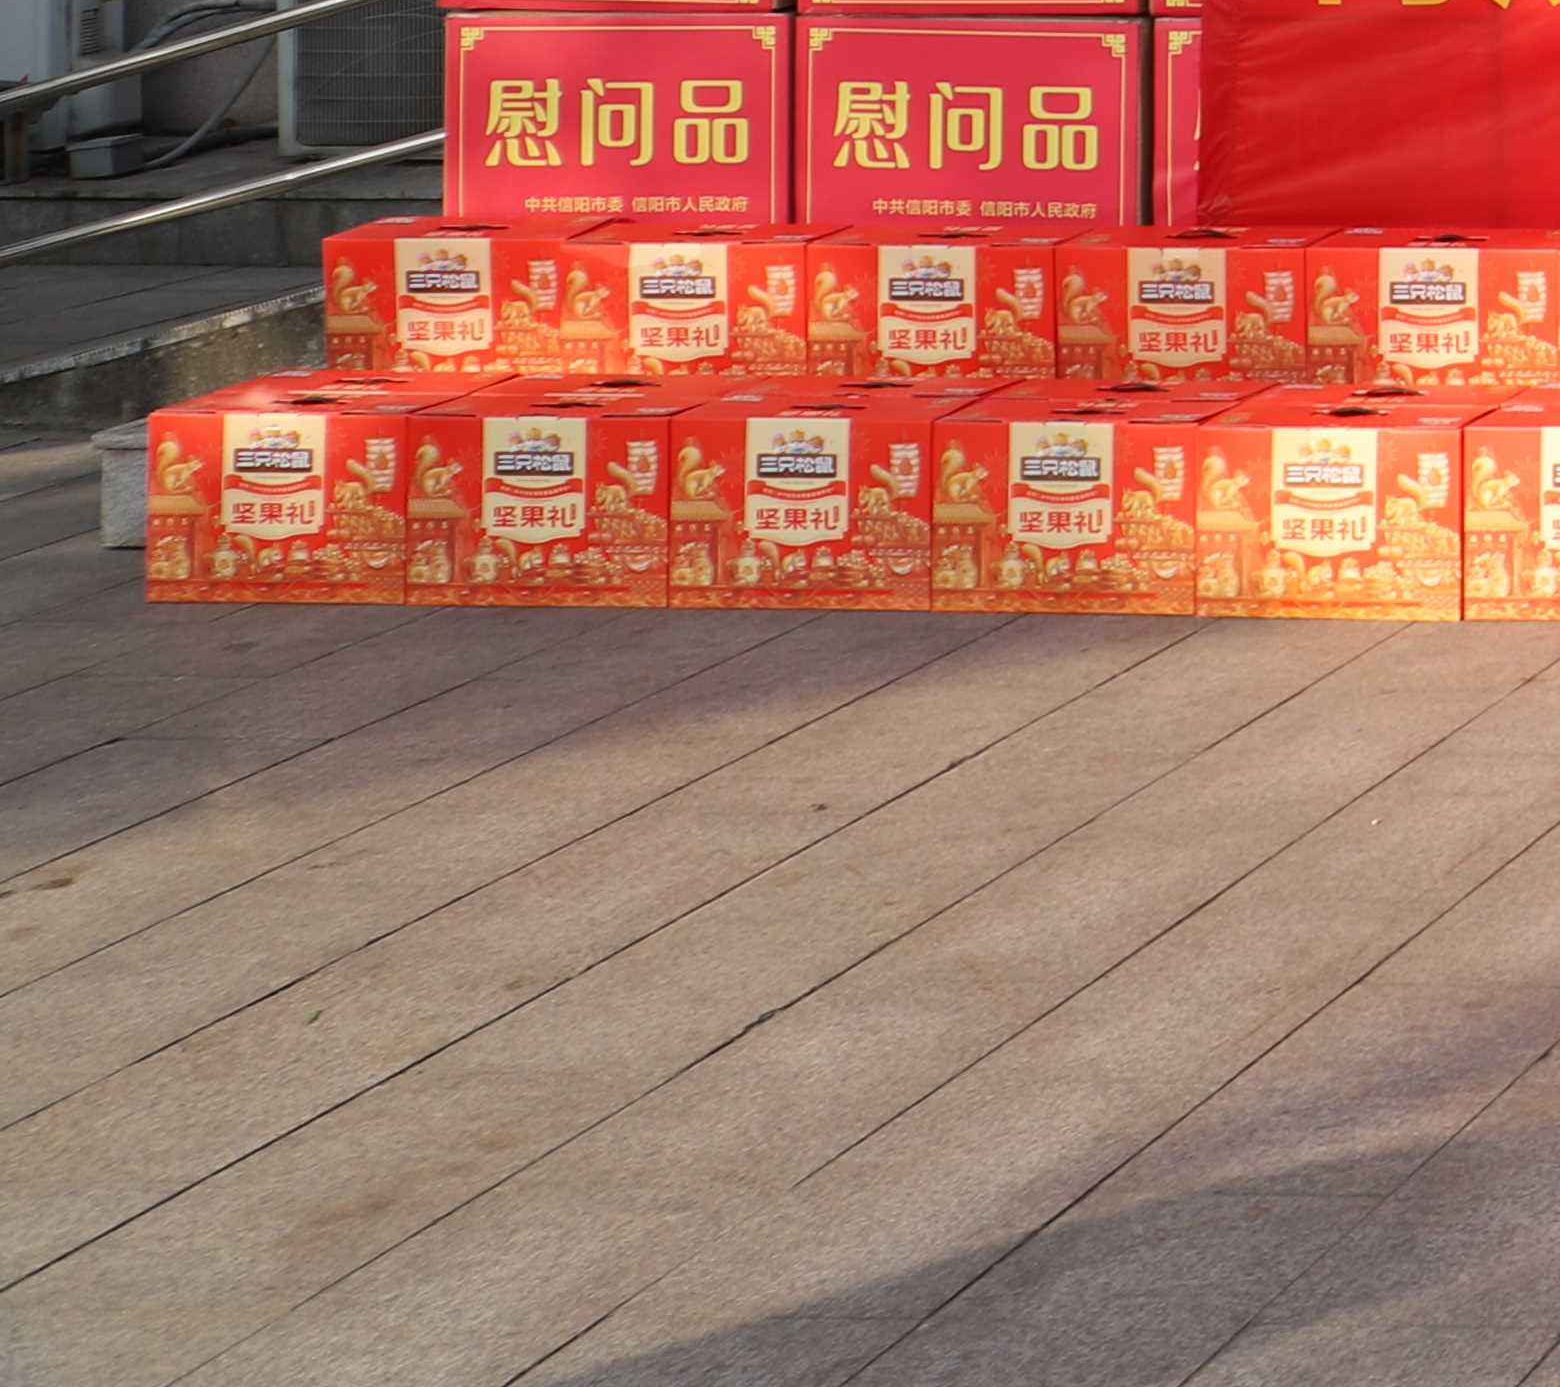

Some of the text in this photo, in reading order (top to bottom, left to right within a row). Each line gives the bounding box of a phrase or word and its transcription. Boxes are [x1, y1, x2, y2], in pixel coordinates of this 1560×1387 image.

[485, 78, 750, 167] 慰问品
[833, 81, 1099, 171] 慰问品
[524, 195, 748, 214] 中共信阳市委 信阳市人民政府
[872, 198, 1097, 218] 中共信阳市委 信阳市人民政府
[408, 273, 479, 289] 三只松鼠
[642, 279, 714, 295] 三只松鼠
[892, 281, 963, 297] 三只松鼠
[1141, 283, 1213, 299] 三只松鼠
[1392, 284, 1464, 300] 三只松鼠
[408, 321, 484, 341] 坚果礼
[641, 327, 719, 347] 坚果礼
[888, 329, 966, 349] 坚果礼
[1139, 332, 1217, 352] 坚果礼
[1389, 333, 1469, 354] 坚果礼
[237, 451, 311, 468] 三只松鼠
[497, 454, 573, 471] 三只松鼠
[760, 456, 836, 473] 三只松鼠
[1023, 459, 1099, 476] 三只松鼠
[1286, 466, 1362, 483] 三只松鼠
[232, 503, 314, 524] 坚果礼
[493, 506, 575, 527] 坚果礼
[755, 508, 838, 530] 坚果礼
[1019, 511, 1102, 533] 坚果礼
[1282, 518, 1365, 540] 坚果礼
